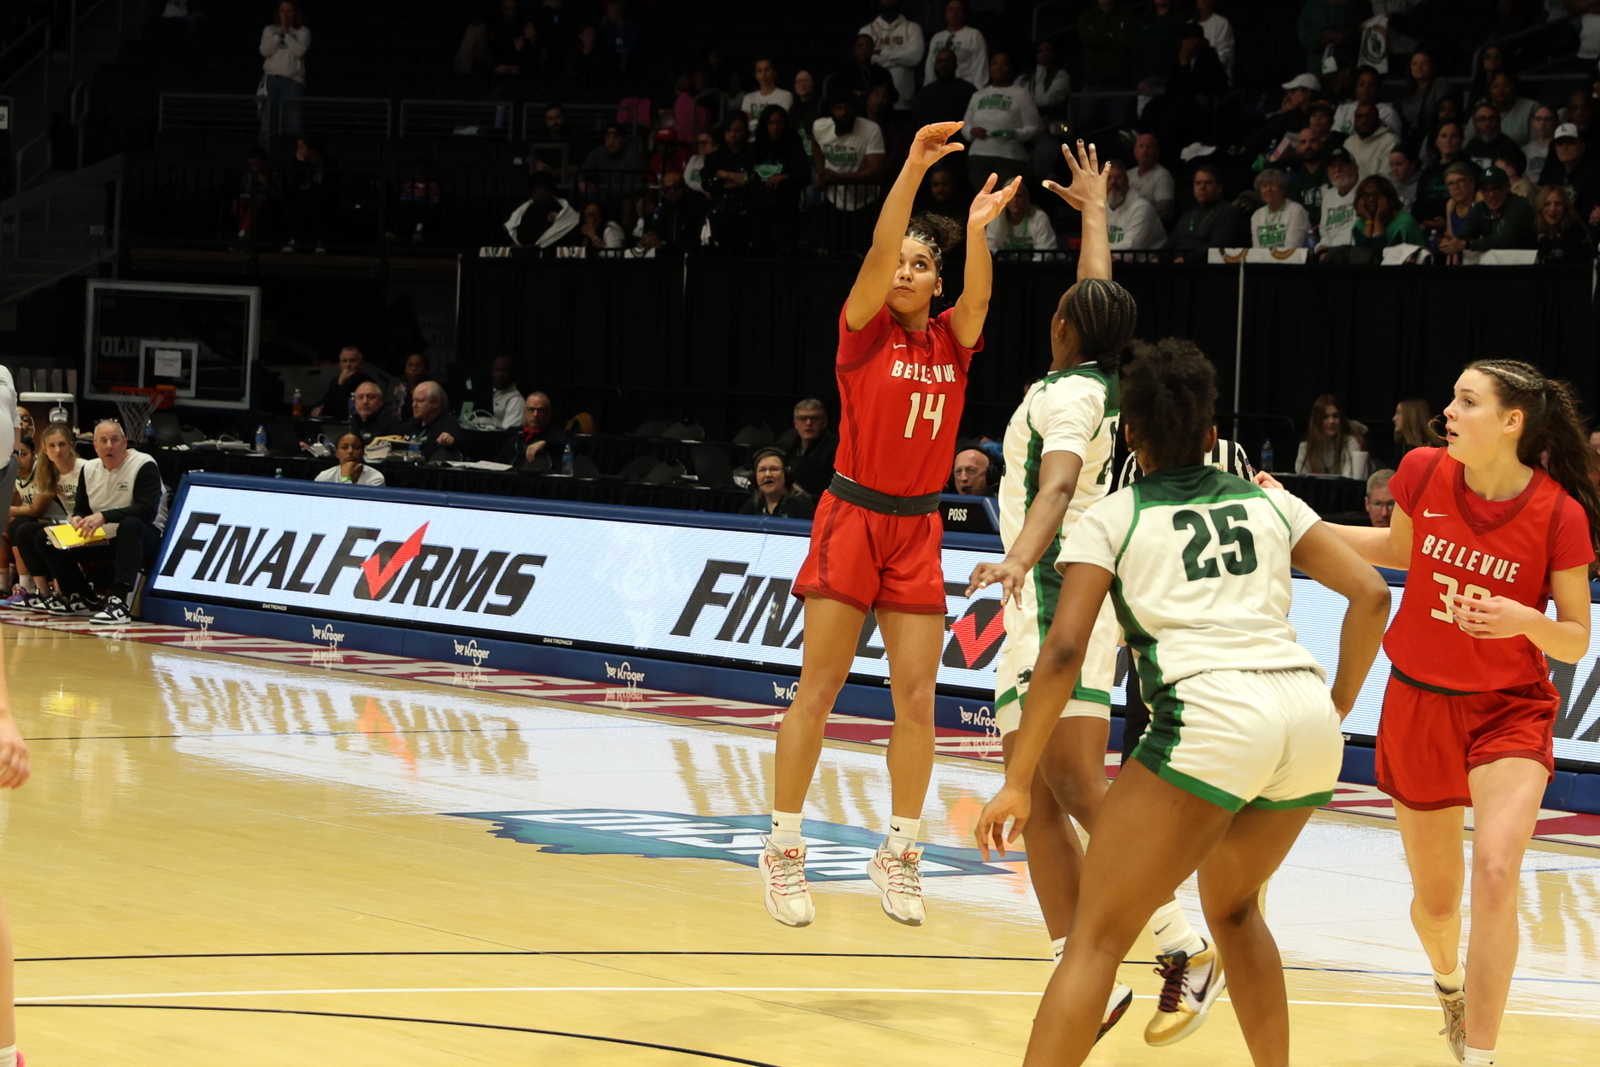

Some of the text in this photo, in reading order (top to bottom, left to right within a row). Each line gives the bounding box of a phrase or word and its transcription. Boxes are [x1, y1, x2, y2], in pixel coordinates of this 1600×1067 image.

[891, 359, 957, 385] BELLEVUE
[904, 391, 946, 440] 14
[947, 507, 968, 522] POSS
[1172, 504, 1258, 582] 25
[159, 511, 548, 617] FINALFORMS
[1421, 533, 1521, 584] BELLEVUE
[192, 606, 215, 631] Kroger
[321, 623, 345, 647] Kroger
[464, 639, 491, 666] Kroger
[617, 661, 645, 688] Kroger
